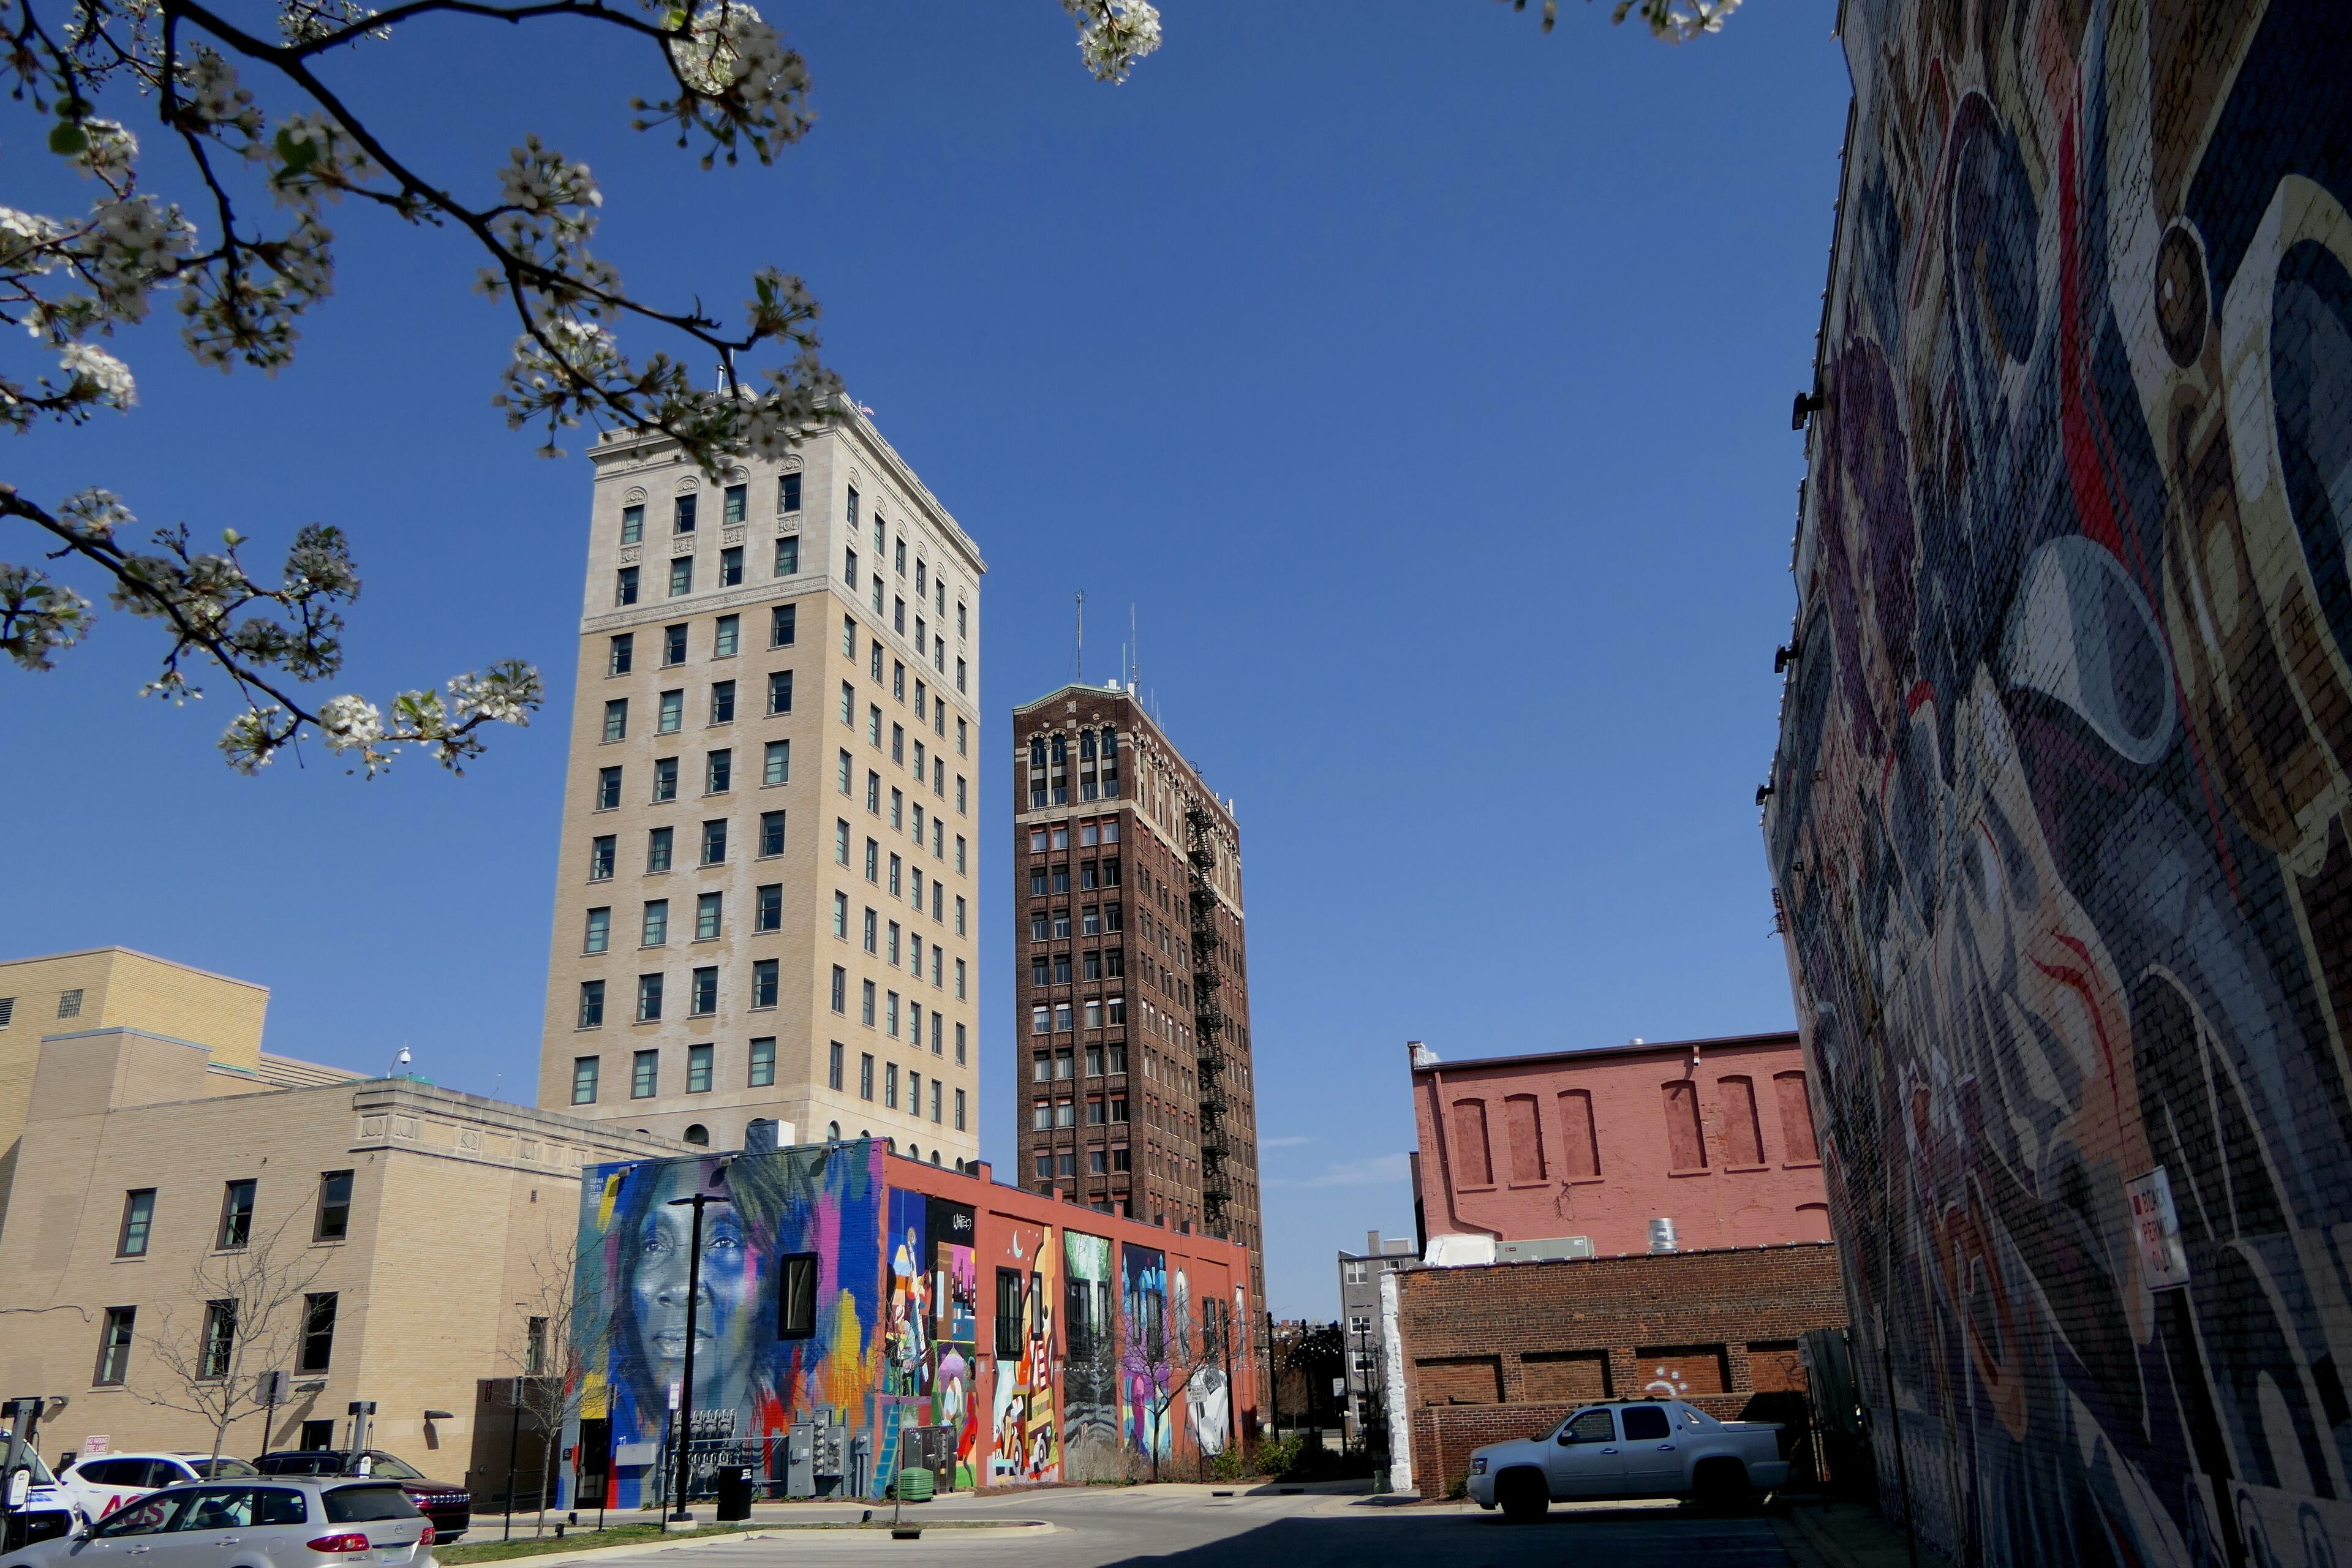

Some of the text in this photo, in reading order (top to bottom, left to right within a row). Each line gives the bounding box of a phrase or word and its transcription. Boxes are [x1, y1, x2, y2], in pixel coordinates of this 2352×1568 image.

[2141, 1185, 2168, 1213] BLACK
[2142, 1216, 2169, 1243] PERMIT
[2152, 1248, 2173, 1272] ONLY
